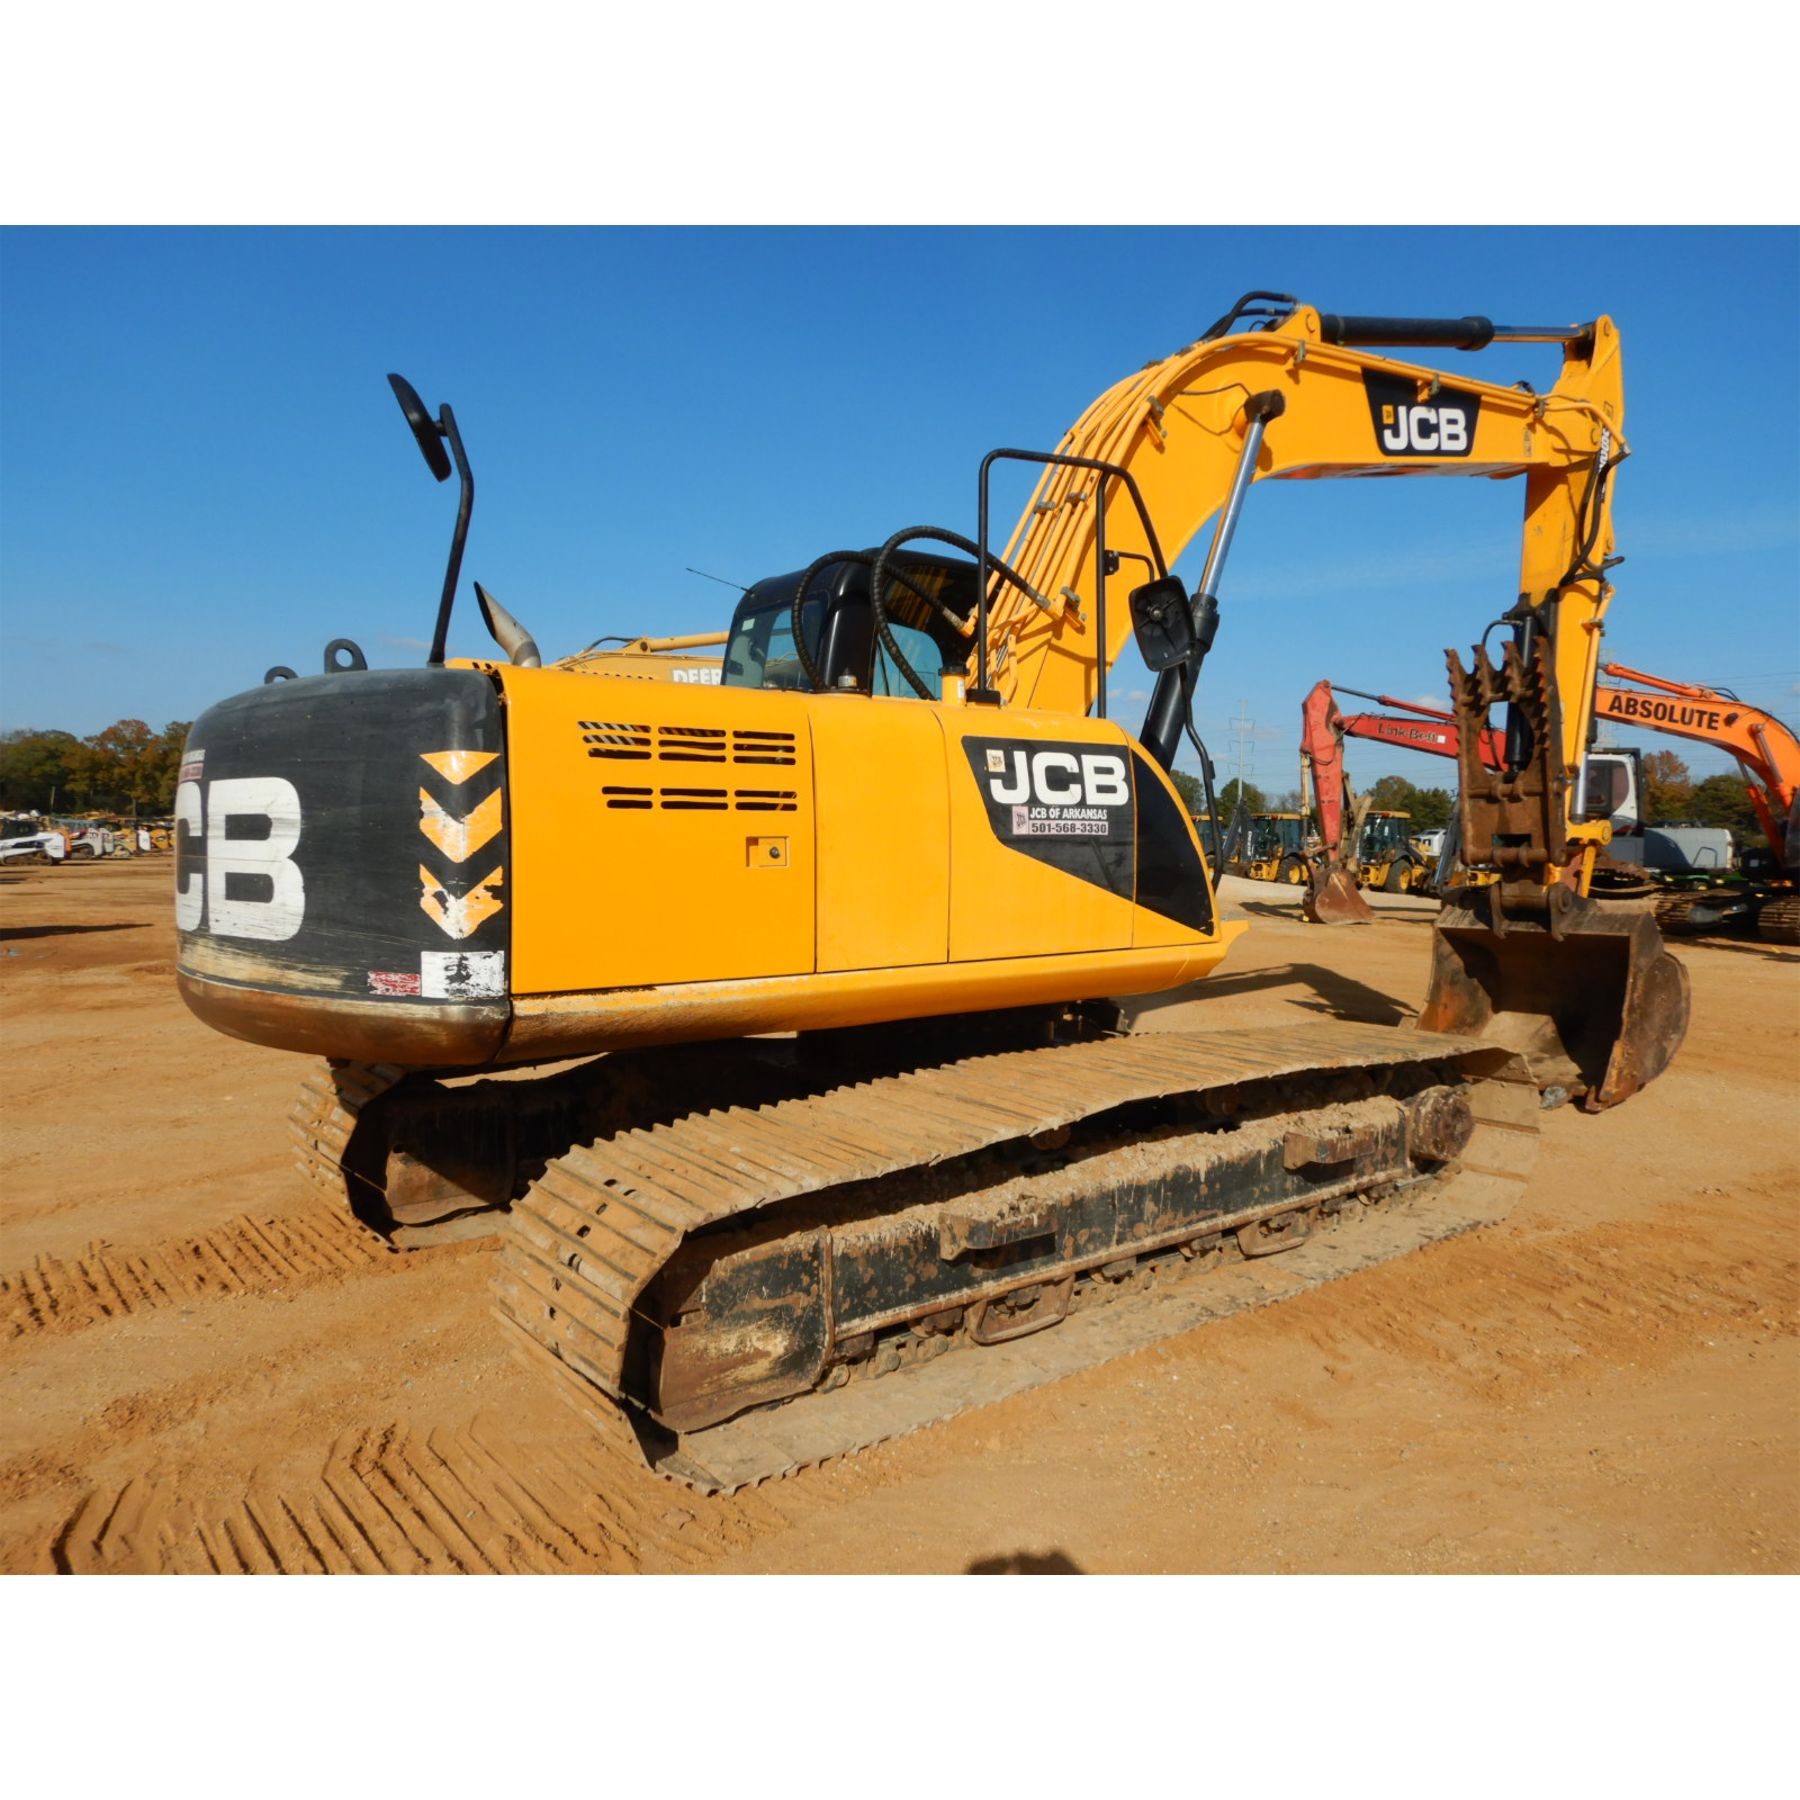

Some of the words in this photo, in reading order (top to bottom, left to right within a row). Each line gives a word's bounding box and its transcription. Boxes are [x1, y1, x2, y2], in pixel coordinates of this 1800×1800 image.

[1383, 405, 1468, 451] JCB
[1608, 695, 1720, 730] ABSOLUTE
[990, 750, 1129, 806] JCB
[1030, 807, 1048, 819] JCB
[1049, 808, 1060, 819] OF
[1062, 808, 1107, 820] ARKANSAS
[1031, 822, 1107, 834] 501-568-3330
